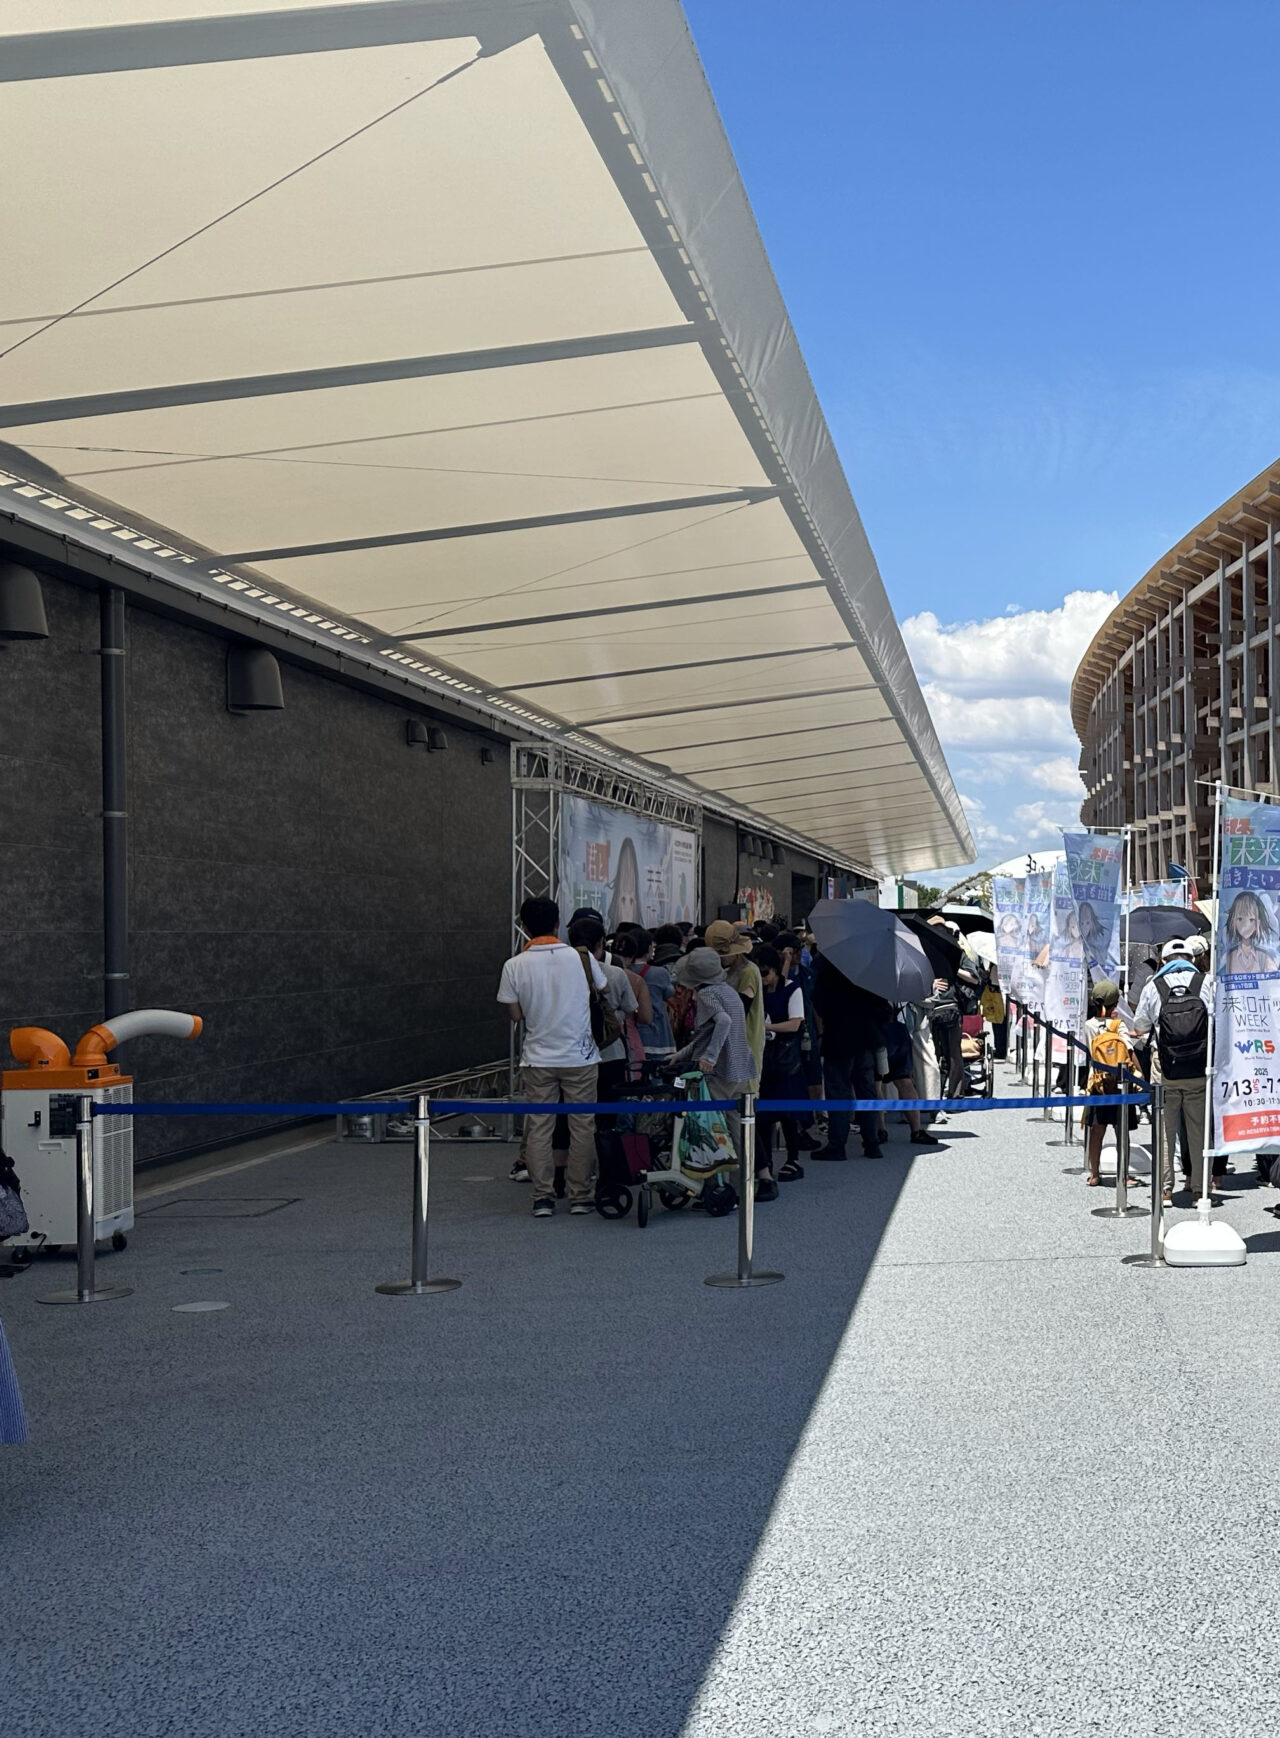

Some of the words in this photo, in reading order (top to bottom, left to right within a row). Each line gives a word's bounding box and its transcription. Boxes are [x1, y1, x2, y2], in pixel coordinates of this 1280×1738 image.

[1235, 1014, 1269, 1027] WEEK
[1234, 1040, 1275, 1054] WRS
[1254, 1068, 1269, 1076] 2025
